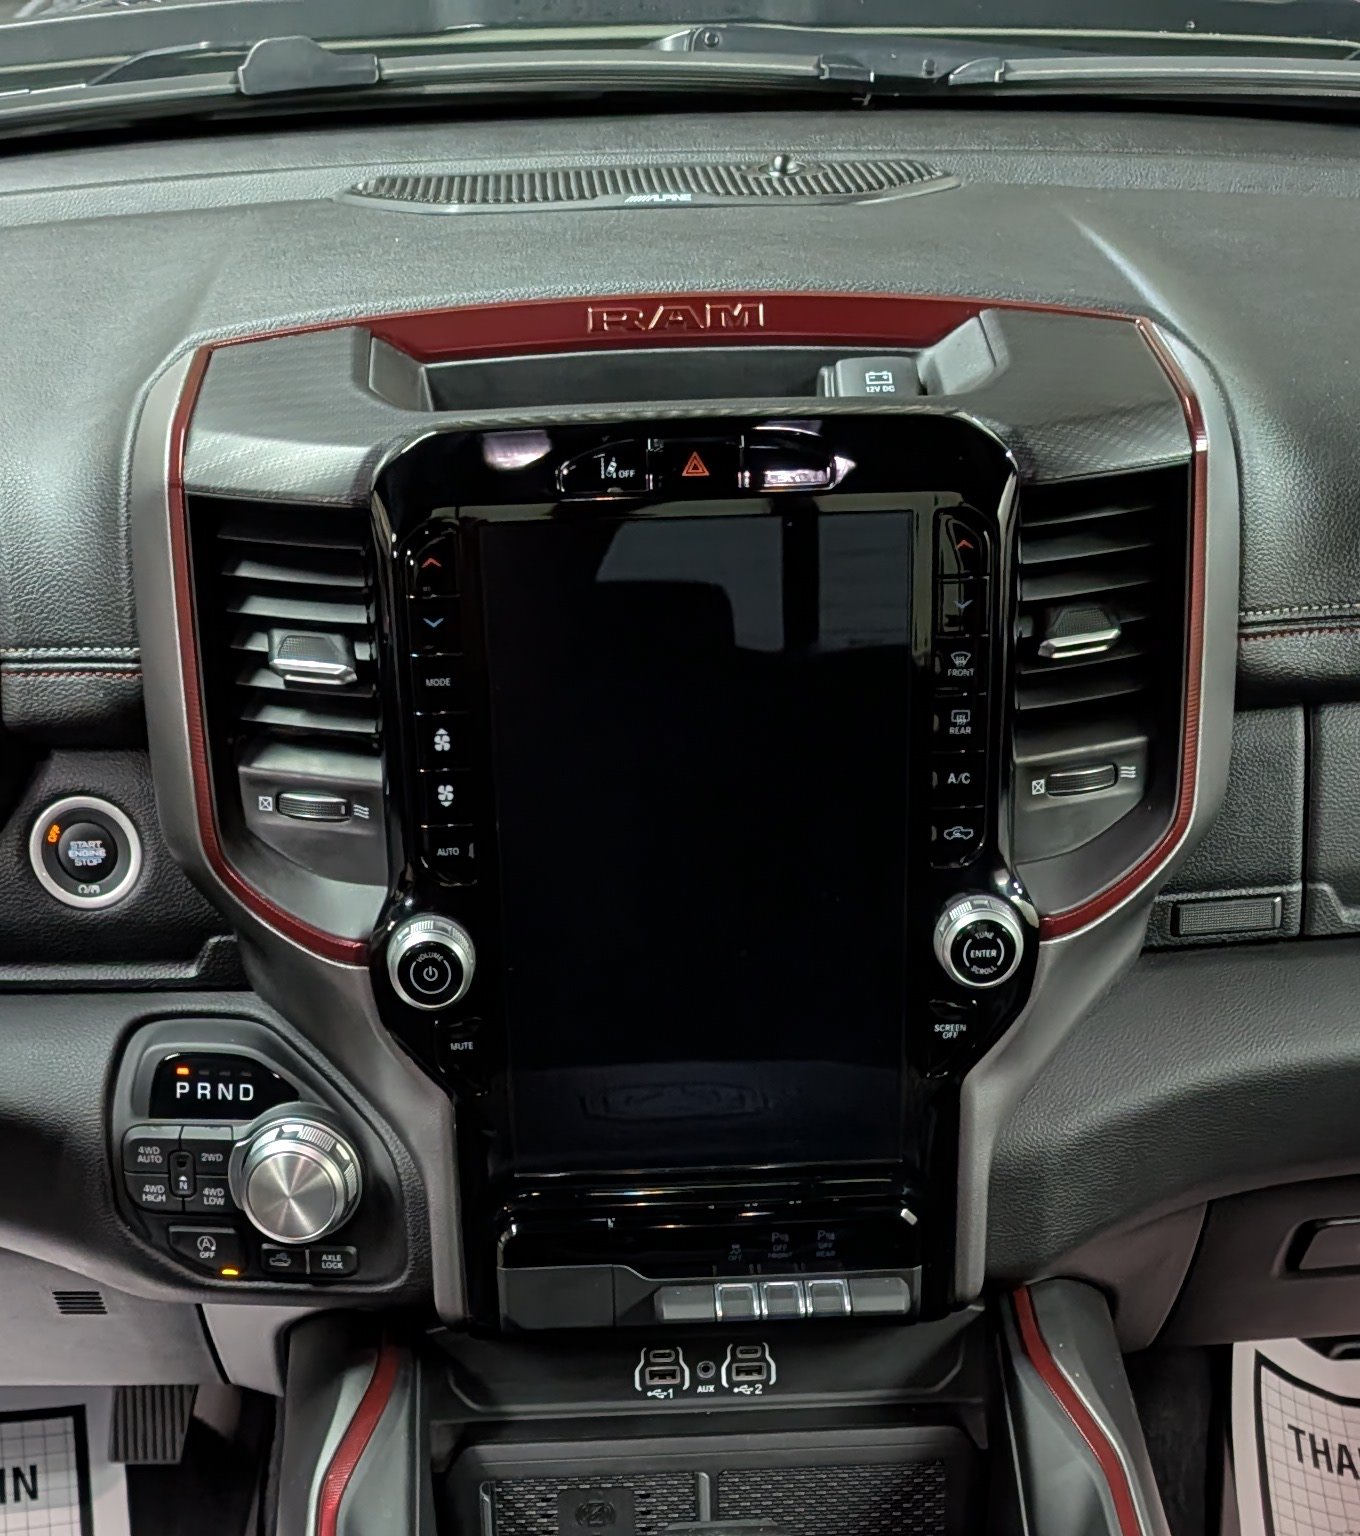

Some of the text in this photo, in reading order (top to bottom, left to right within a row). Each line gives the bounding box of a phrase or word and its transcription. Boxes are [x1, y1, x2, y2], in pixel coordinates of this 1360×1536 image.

[587, 303, 764, 332] RAM
[866, 385, 881, 393] 12V
[618, 469, 636, 479] OFF
[426, 677, 451, 687] MODE
[949, 726, 972, 735] REAR
[947, 773, 971, 785] A/C
[68, 840, 102, 849] START
[67, 848, 106, 858] ENGINE
[436, 847, 460, 857] AUTO
[74, 858, 102, 867] STOP
[974, 931, 994, 940] TUNE
[415, 951, 444, 963] VOLUME
[970, 949, 997, 959] ENTER
[970, 964, 998, 975] SCROLL
[933, 1023, 967, 1033] SCREEN
[942, 1031, 959, 1040] OFF
[450, 1041, 474, 1051] MUTE
[175, 1081, 254, 1101] P R N D
[138, 1146, 161, 1155] 4WD
[137, 1155, 163, 1164] AUTO
[201, 1153, 224, 1162] 2WD
[143, 1184, 165, 1194] 4WD
[179, 1181, 189, 1190] N
[202, 1187, 225, 1197] 4WD
[142, 1193, 166, 1203] HIGH
[203, 1196, 225, 1206] LOW
[199, 1251, 216, 1260] OFF
[321, 1254, 342, 1262] AXLE
[321, 1261, 344, 1270] LOCK
[696, 1384, 715, 1394] AUX
